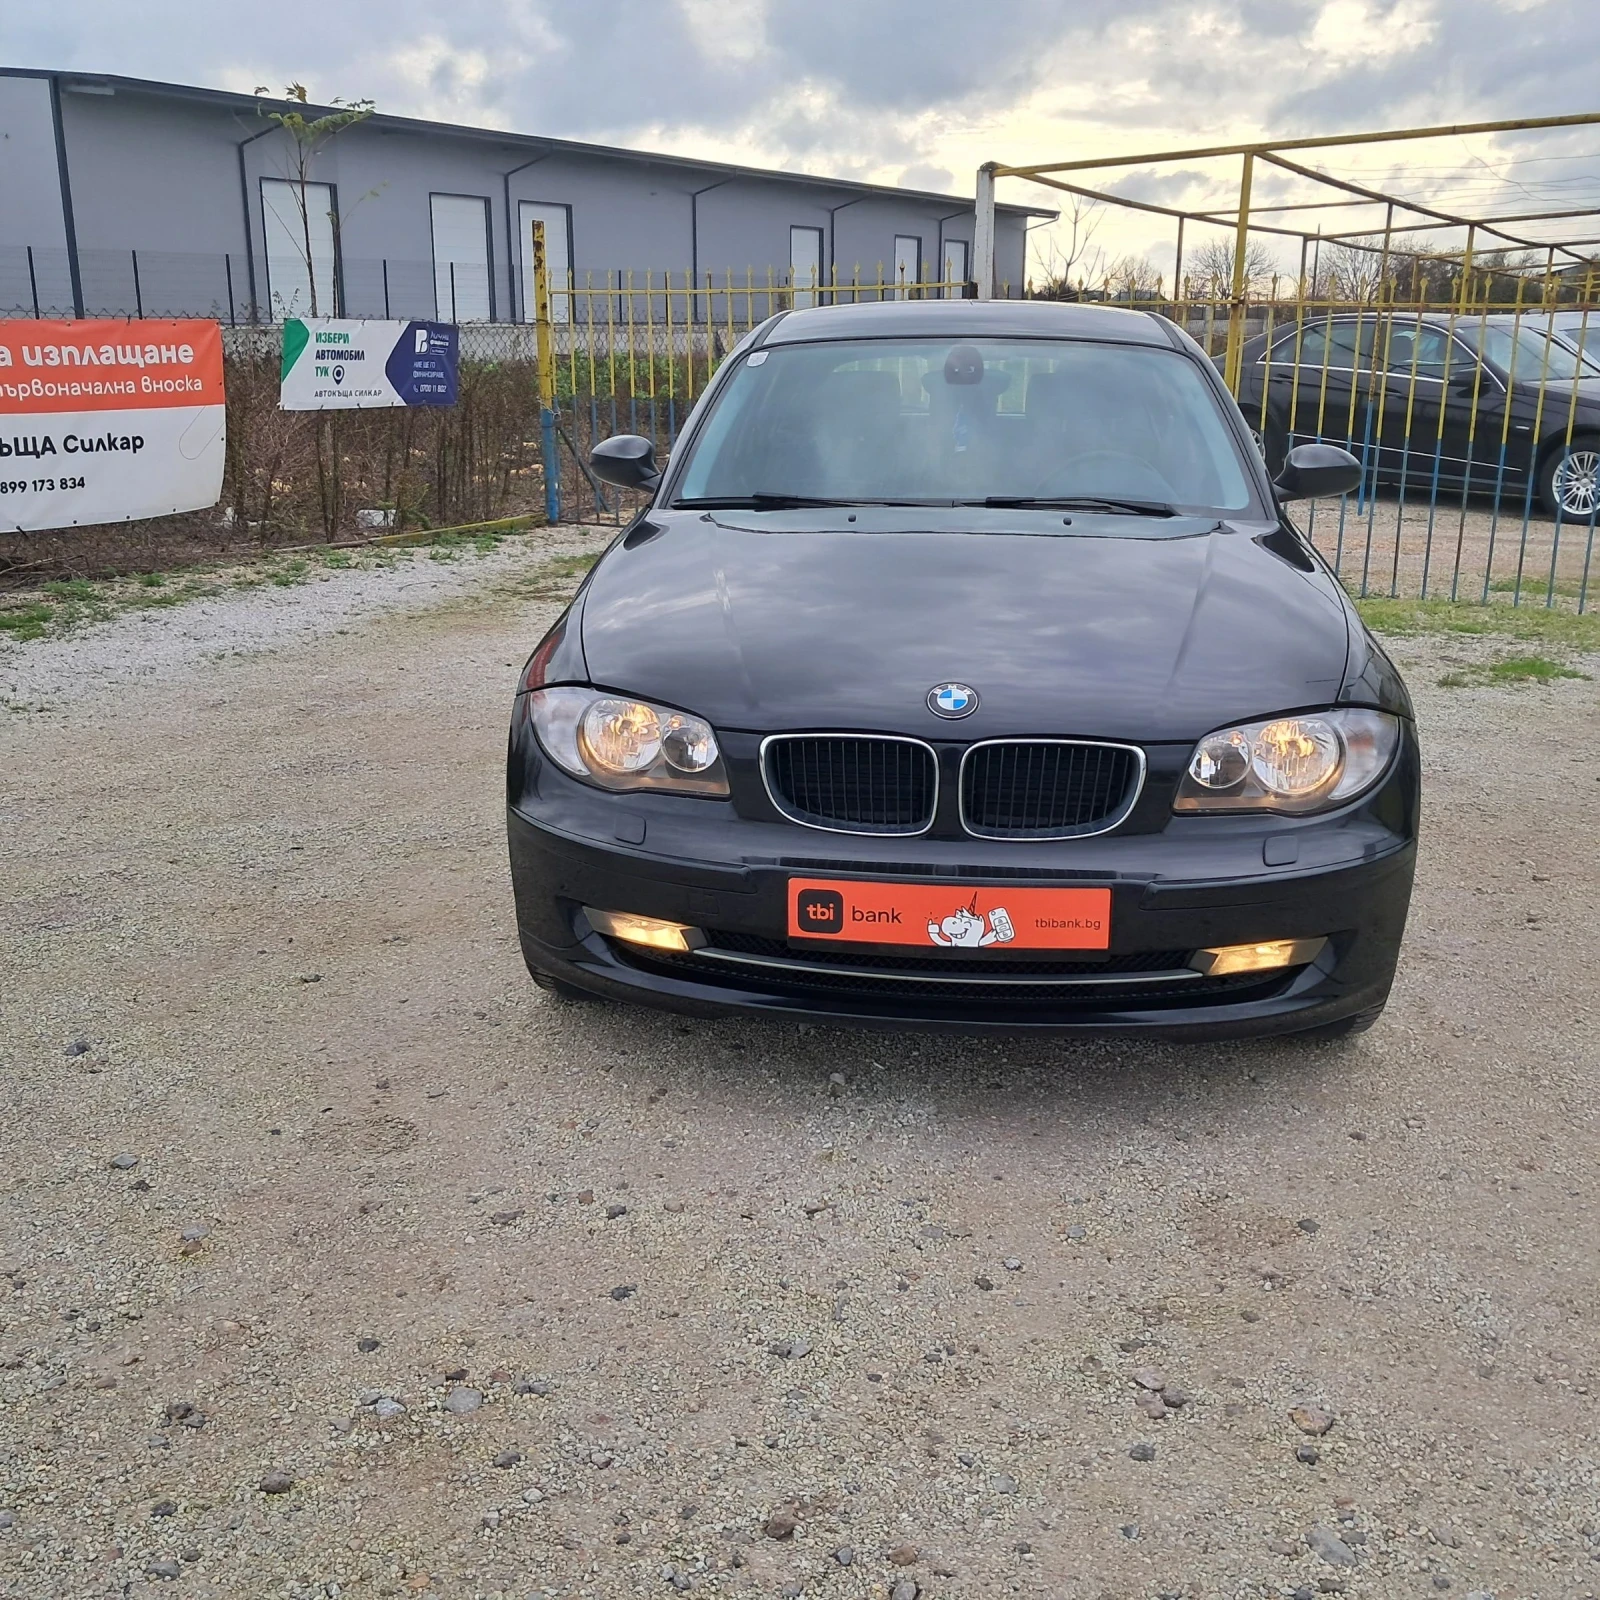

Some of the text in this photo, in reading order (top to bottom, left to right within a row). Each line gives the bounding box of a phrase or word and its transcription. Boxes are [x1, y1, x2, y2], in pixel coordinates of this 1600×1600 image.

[315, 332, 350, 344] ИЗБЕРИ
[22, 344, 193, 367] изплащане
[315, 350, 365, 361] АВТОМОБИЛ
[315, 366, 329, 377] ТУК
[0, 374, 203, 401] ървоначална вноска
[314, 389, 383, 398] АВТОКЪЩА СИЛКАР
[62, 432, 145, 454] Силкар
[31, 478, 56, 492] 173
[59, 476, 86, 490] 834
[806, 903, 902, 925] tbi bank
[1034, 917, 1101, 931] tbibank.bg
